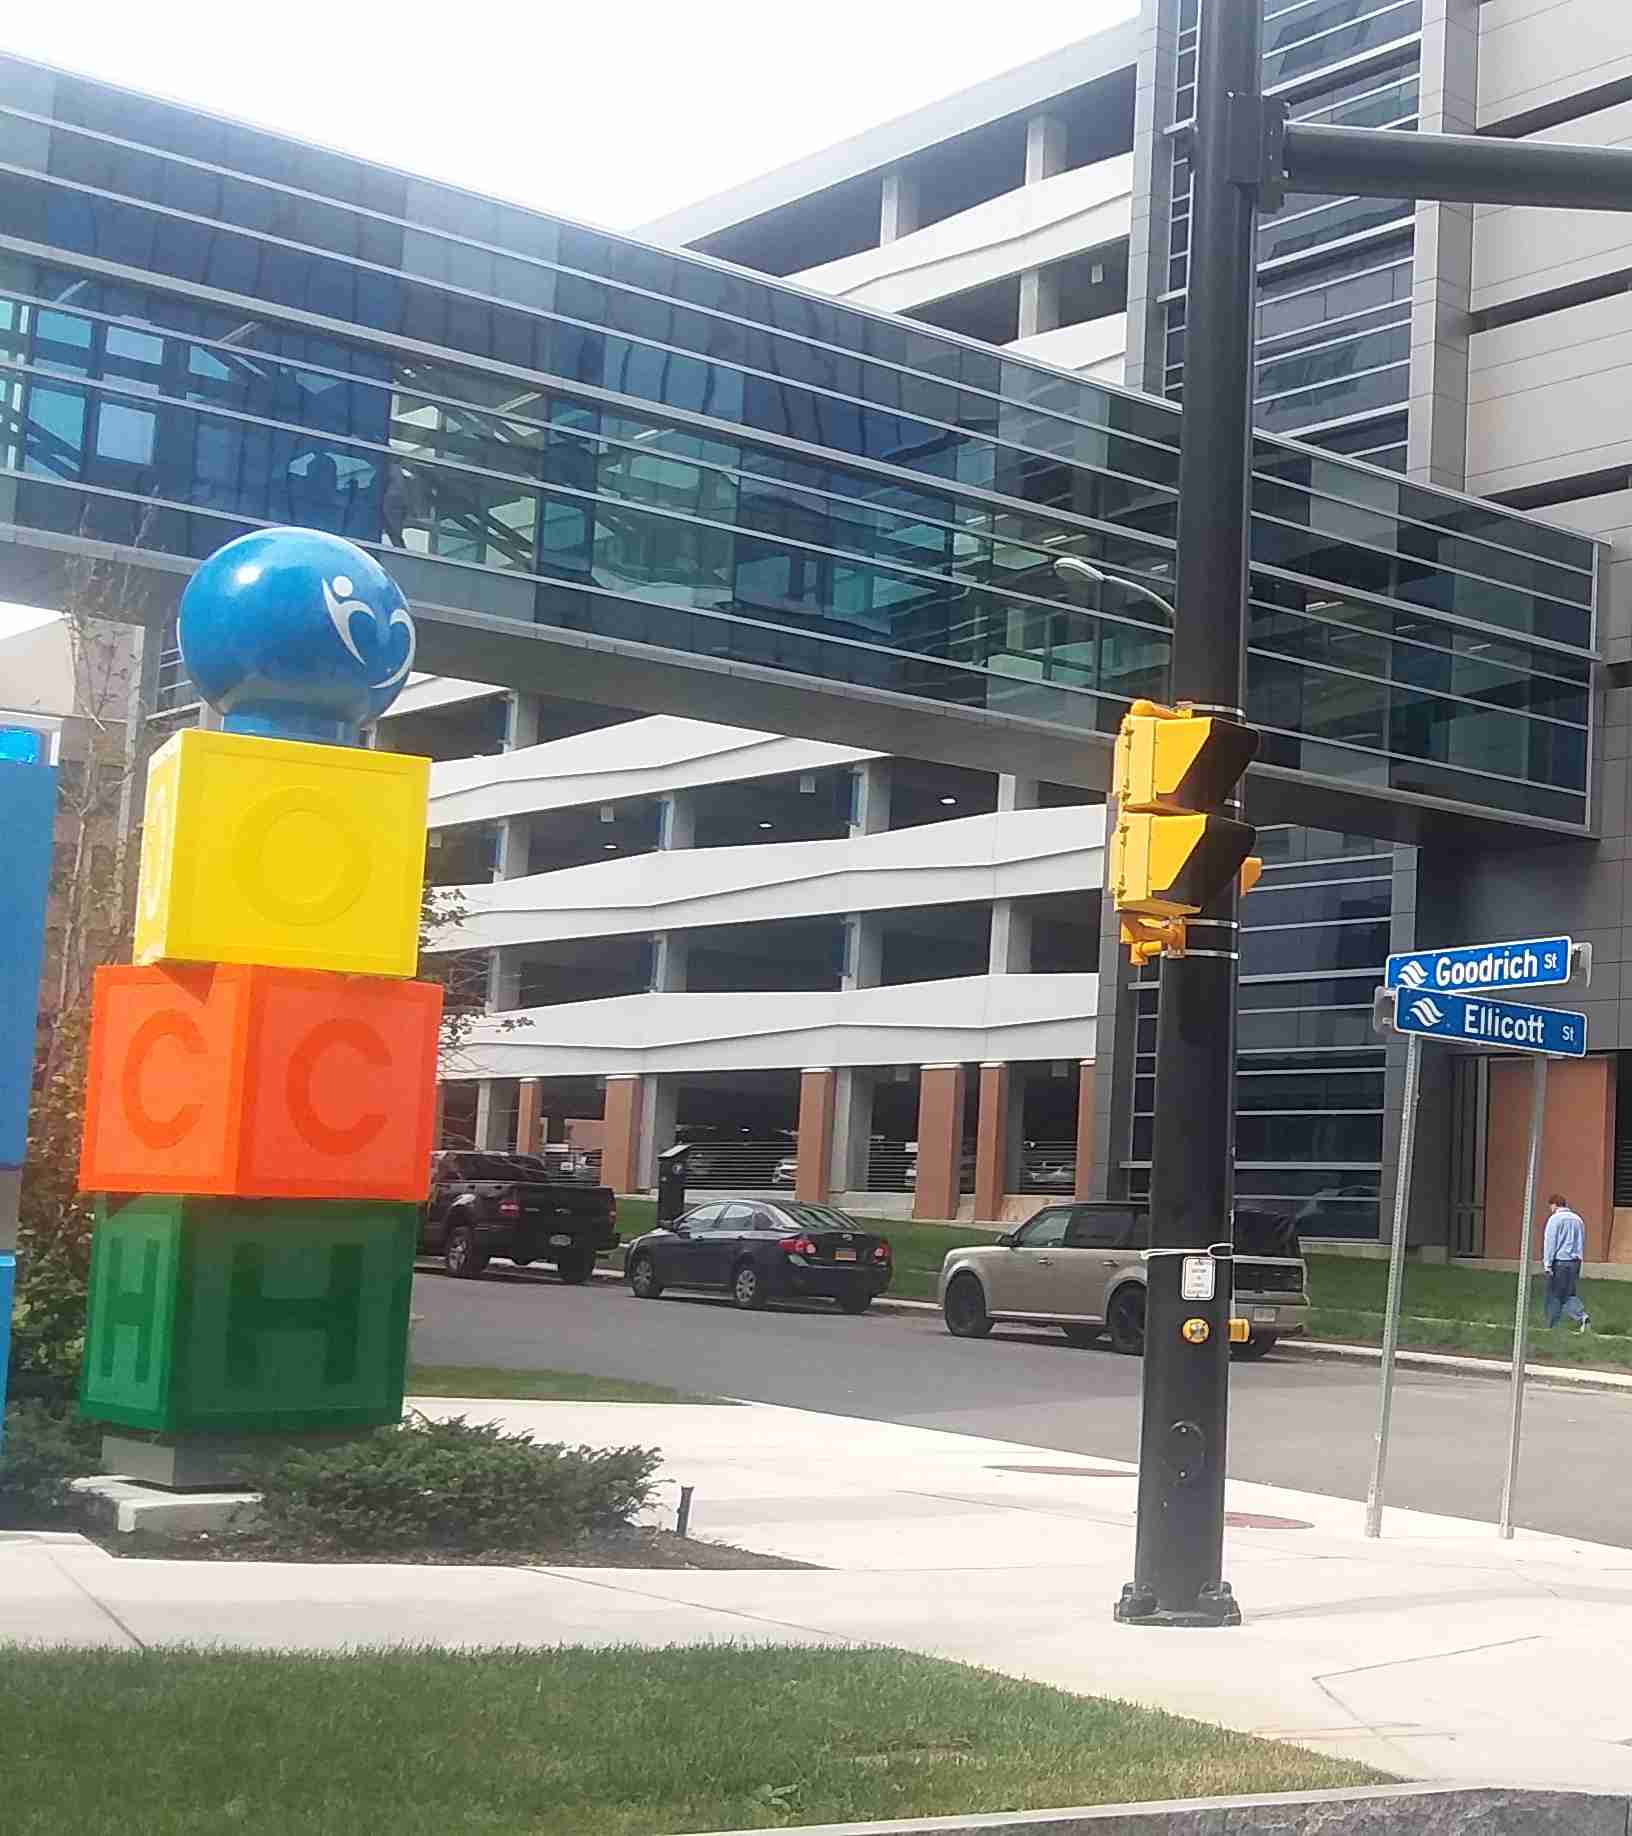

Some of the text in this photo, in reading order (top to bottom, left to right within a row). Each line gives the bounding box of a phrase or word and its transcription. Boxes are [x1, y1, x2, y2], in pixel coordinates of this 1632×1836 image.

[233, 785, 372, 926] O
[1435, 949, 1558, 987] Goodrich St
[1463, 1003, 1576, 1045] Ellicott St
[121, 1008, 208, 1150] C
[286, 1017, 394, 1155] C
[99, 1236, 160, 1385] H
[225, 1241, 364, 1387] H
